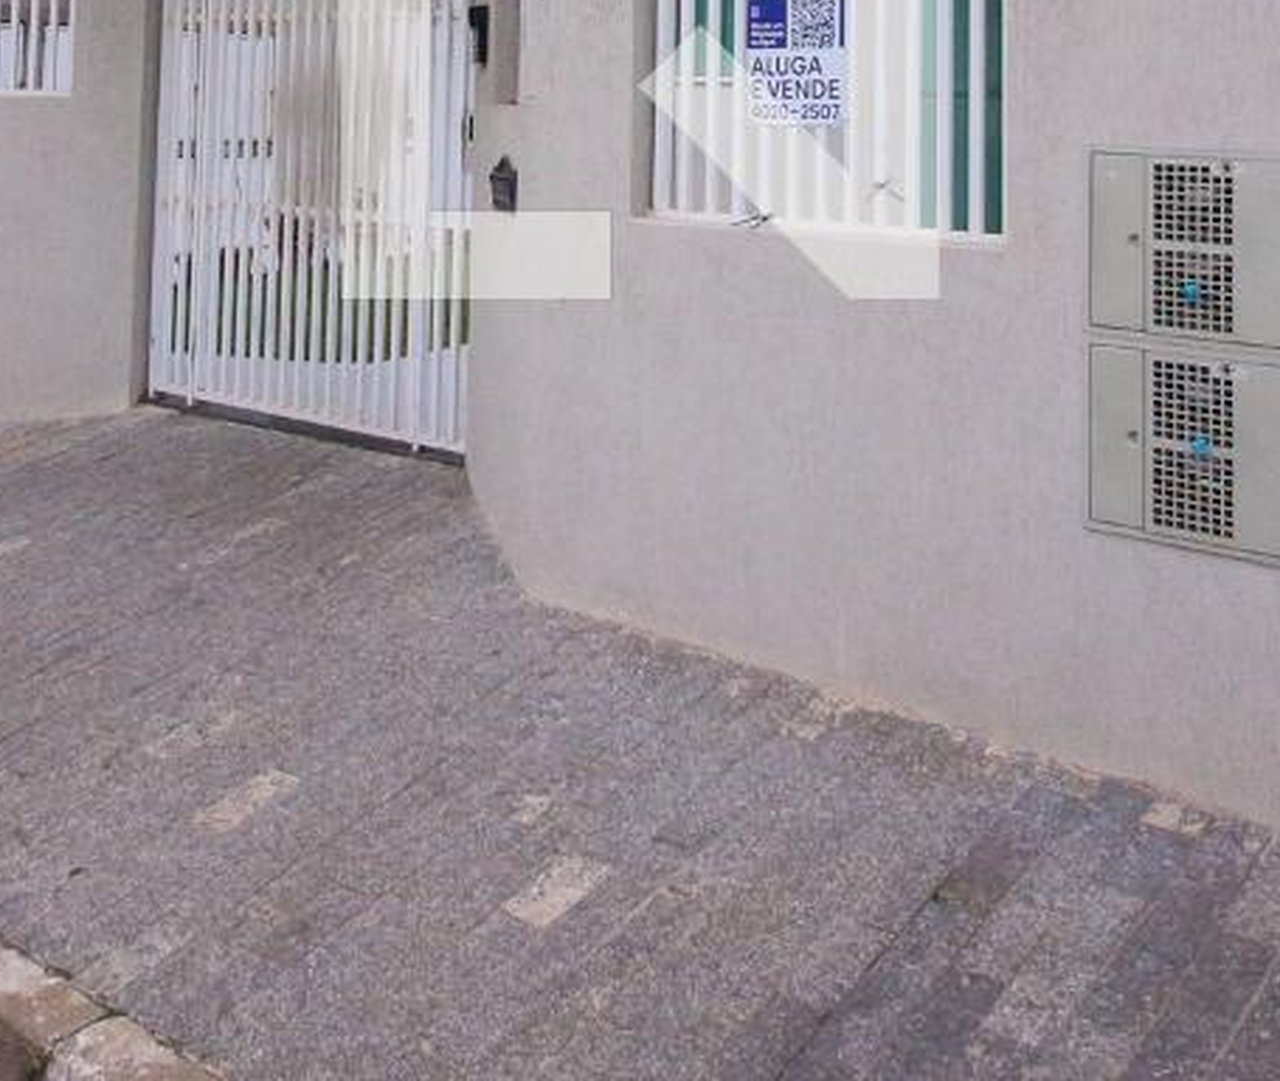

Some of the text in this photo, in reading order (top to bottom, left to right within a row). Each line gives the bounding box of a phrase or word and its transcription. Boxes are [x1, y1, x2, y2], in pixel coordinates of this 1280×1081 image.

[750, 56, 823, 77] ALUGA
[751, 78, 841, 100] E VENDE
